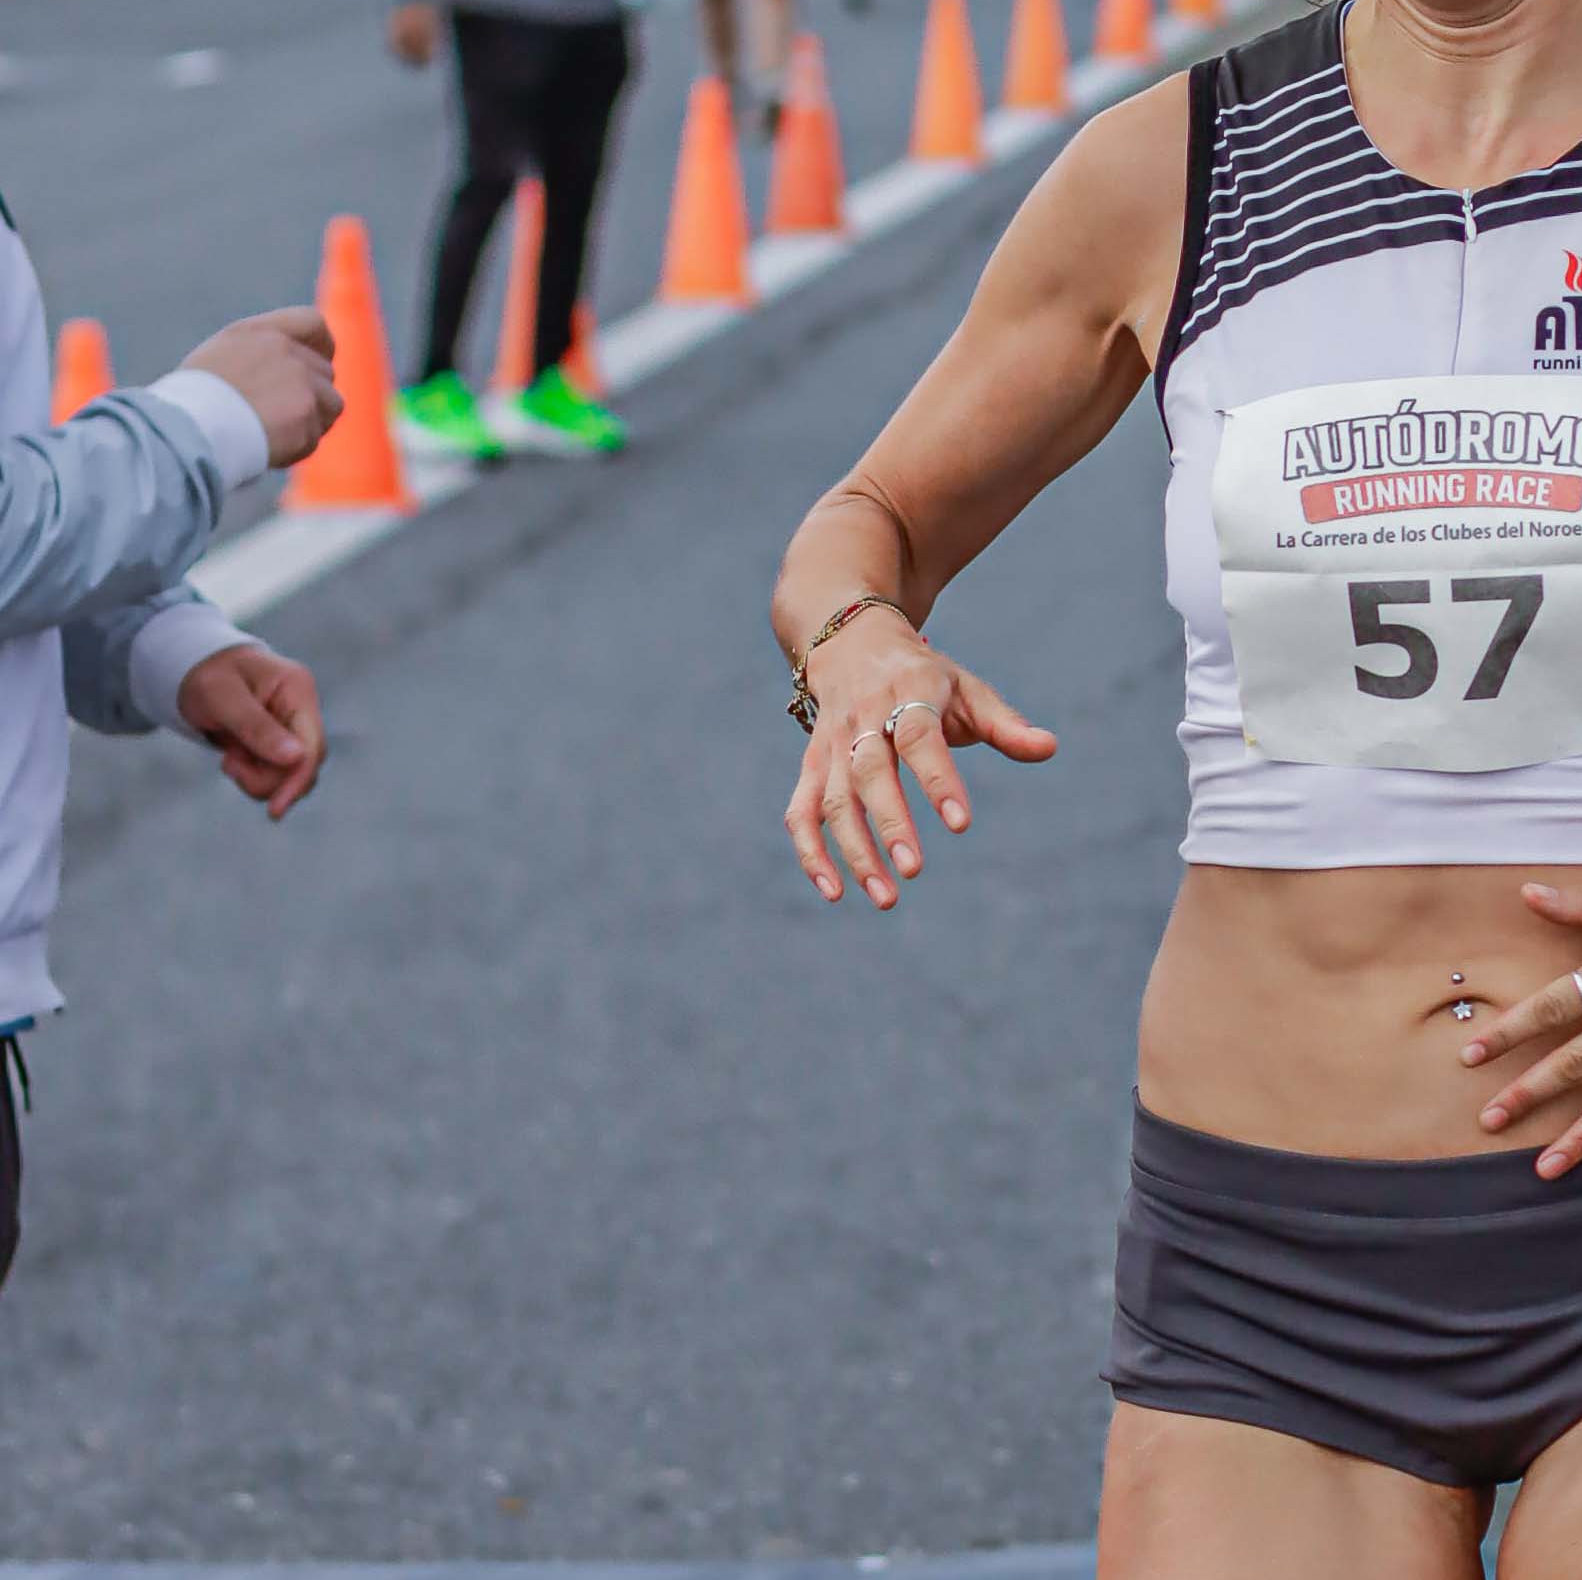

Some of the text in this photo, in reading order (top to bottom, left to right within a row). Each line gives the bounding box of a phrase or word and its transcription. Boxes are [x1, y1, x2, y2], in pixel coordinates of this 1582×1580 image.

[1333, 473, 1553, 516] RUNNING RACE
[1276, 532, 1296, 548] La
[1301, 530, 1368, 548] Carrera
[1373, 526, 1396, 544] de
[1401, 525, 1426, 542] los
[1431, 523, 1492, 541] Clubes
[1496, 521, 1524, 539] del
[1347, 574, 1544, 701] 57
